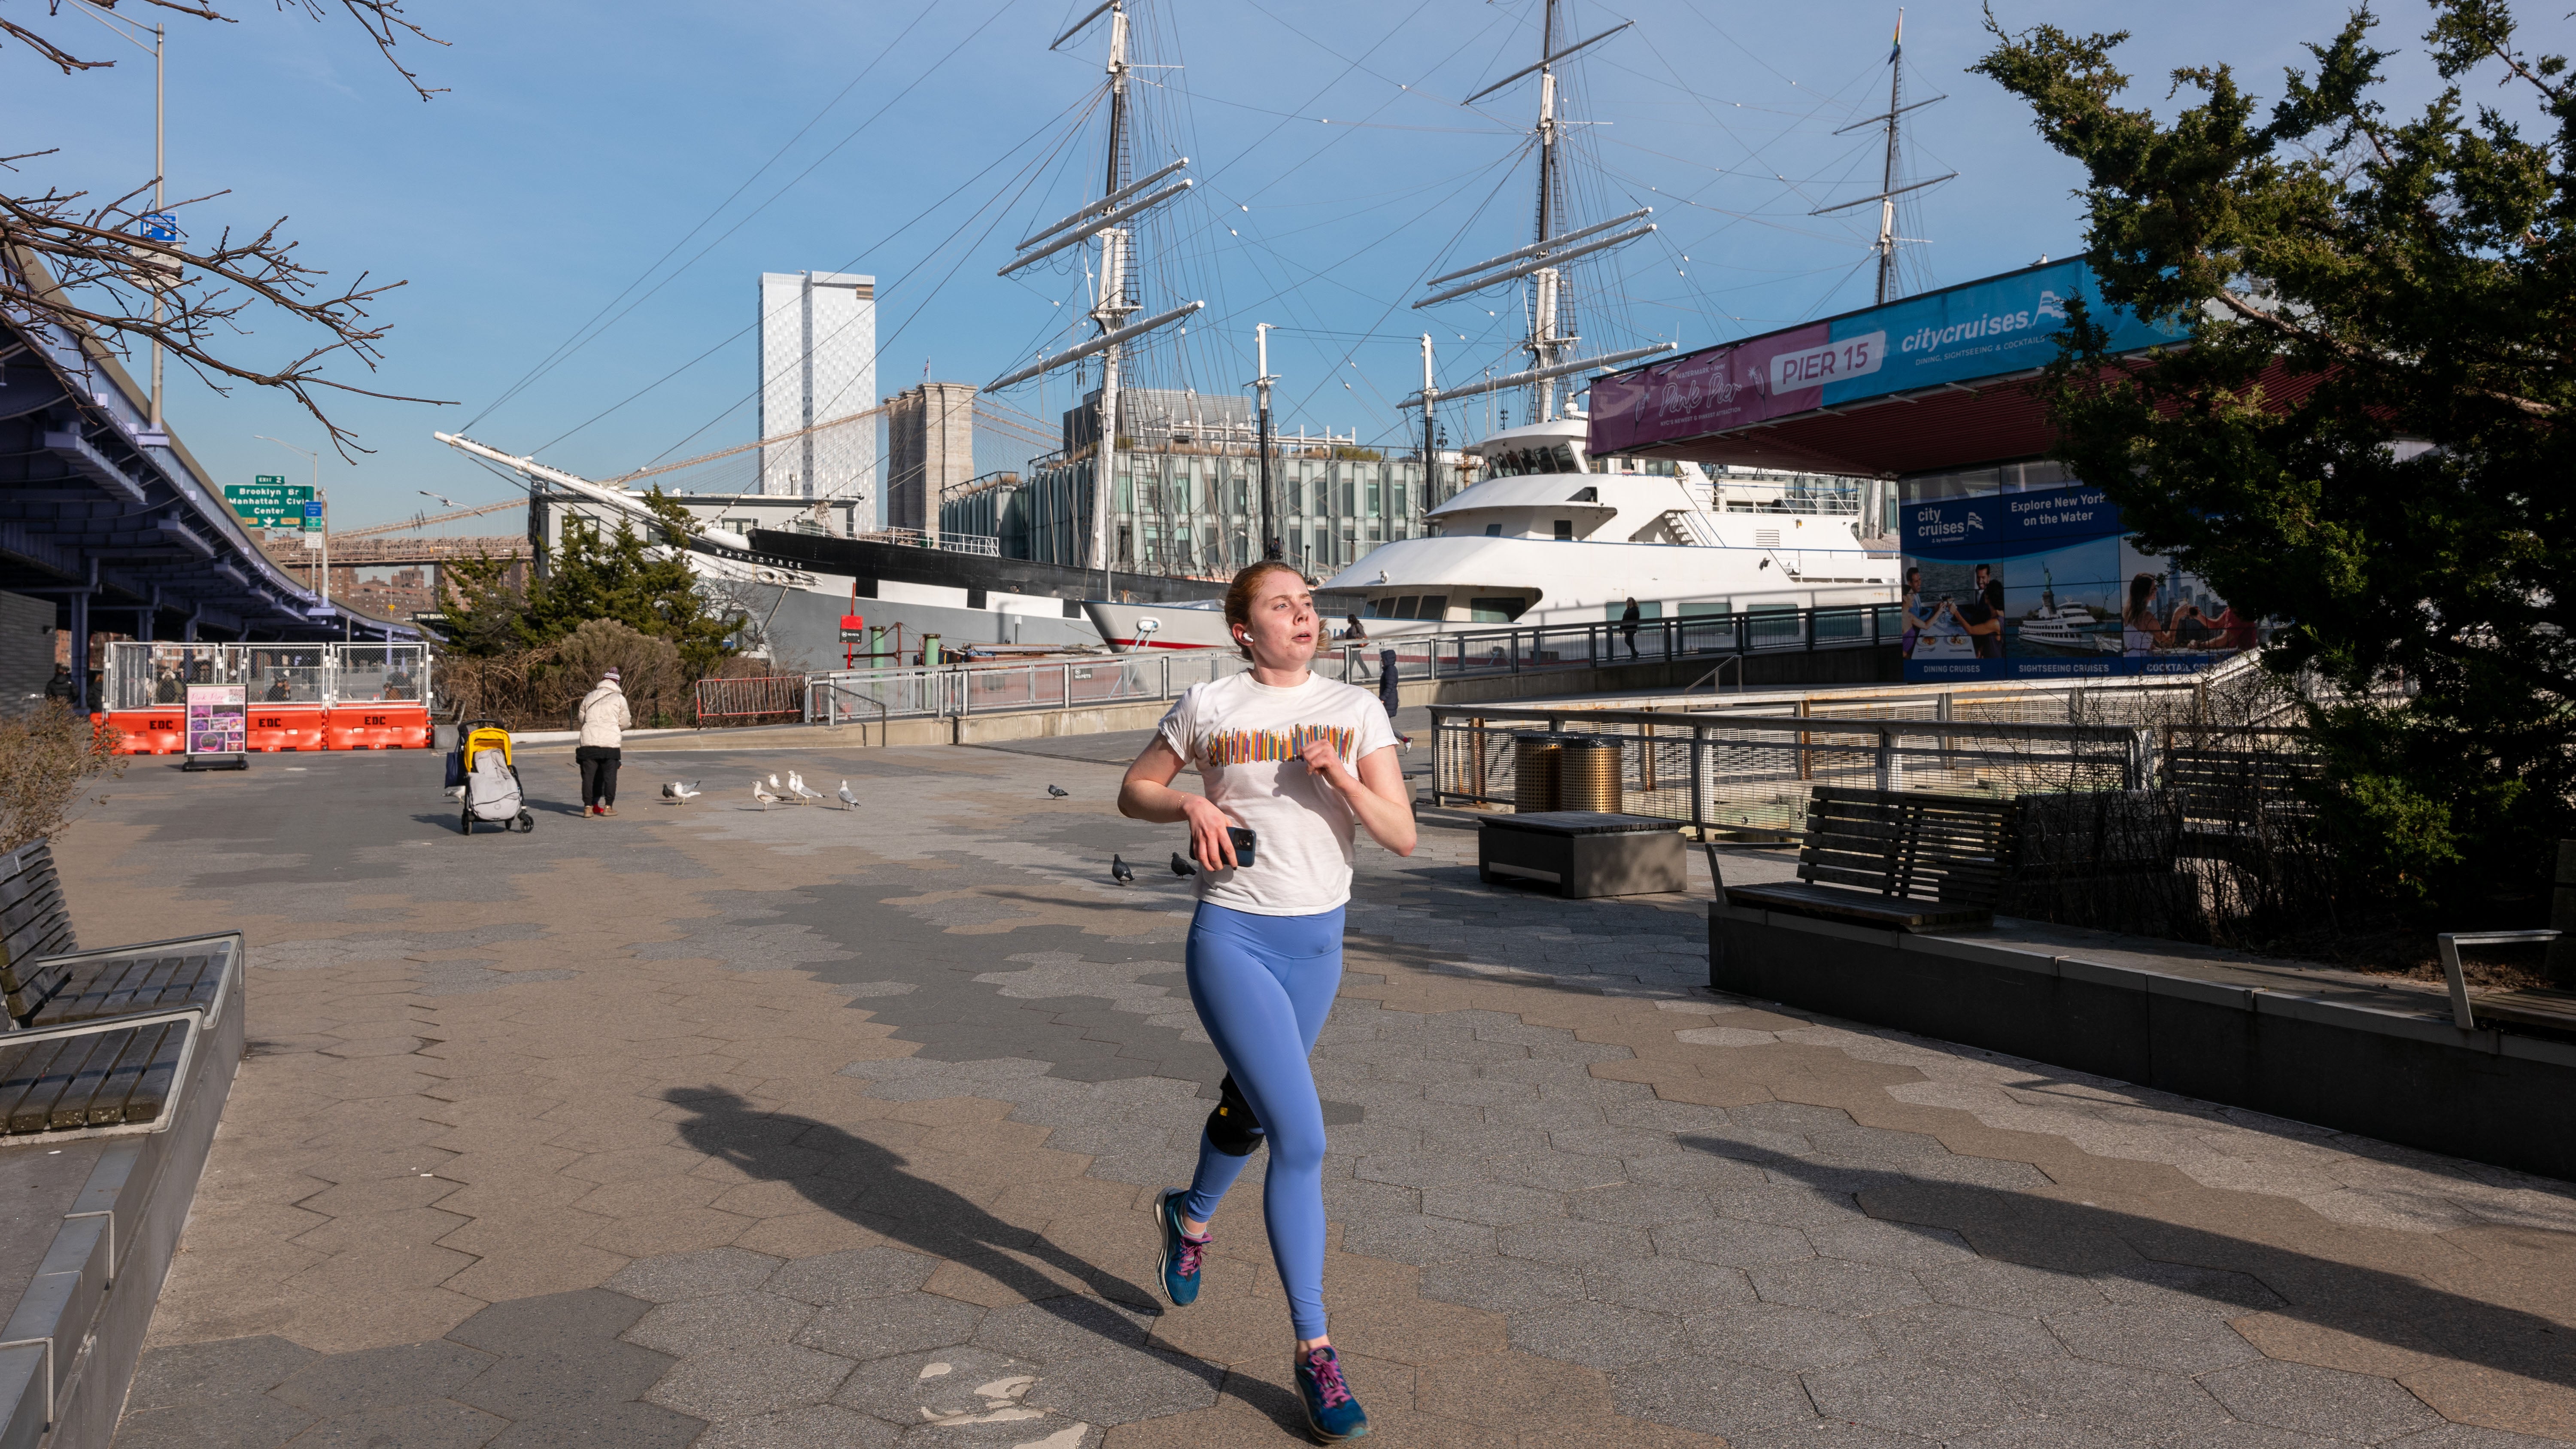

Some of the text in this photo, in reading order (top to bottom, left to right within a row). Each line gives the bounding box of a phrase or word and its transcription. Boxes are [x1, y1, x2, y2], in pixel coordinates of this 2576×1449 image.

[1902, 310, 2029, 352] citycruises
[1915, 355, 1942, 366] DINING,
[1944, 345, 1993, 360] SIGHTSEEING
[2004, 335, 2045, 350] COCKTAILS
[1675, 367, 1710, 380] WATERMARK
[1714, 363, 1726, 371] fever
[1783, 342, 1868, 385] PIER 15
[1659, 372, 1742, 417] Pink Pier
[1674, 416, 1692, 424] NEWEST
[1716, 407, 1741, 416] ATTRACTION
[239, 488, 281, 497] Brooklyn
[2011, 493, 2105, 513] Explore New York
[1918, 507, 1941, 523] city
[2023, 511, 2093, 526] on the Water
[1918, 521, 1965, 537] cruises
[716, 548, 802, 569] WAVERTREE
[2019, 664, 2109, 673] SIGHTSEEING CRUISES
[2147, 663, 2191, 672] COCKTAIL
[149, 720, 173, 730] EDC
[258, 718, 281, 727] EDC
[365, 716, 386, 725] EDC
